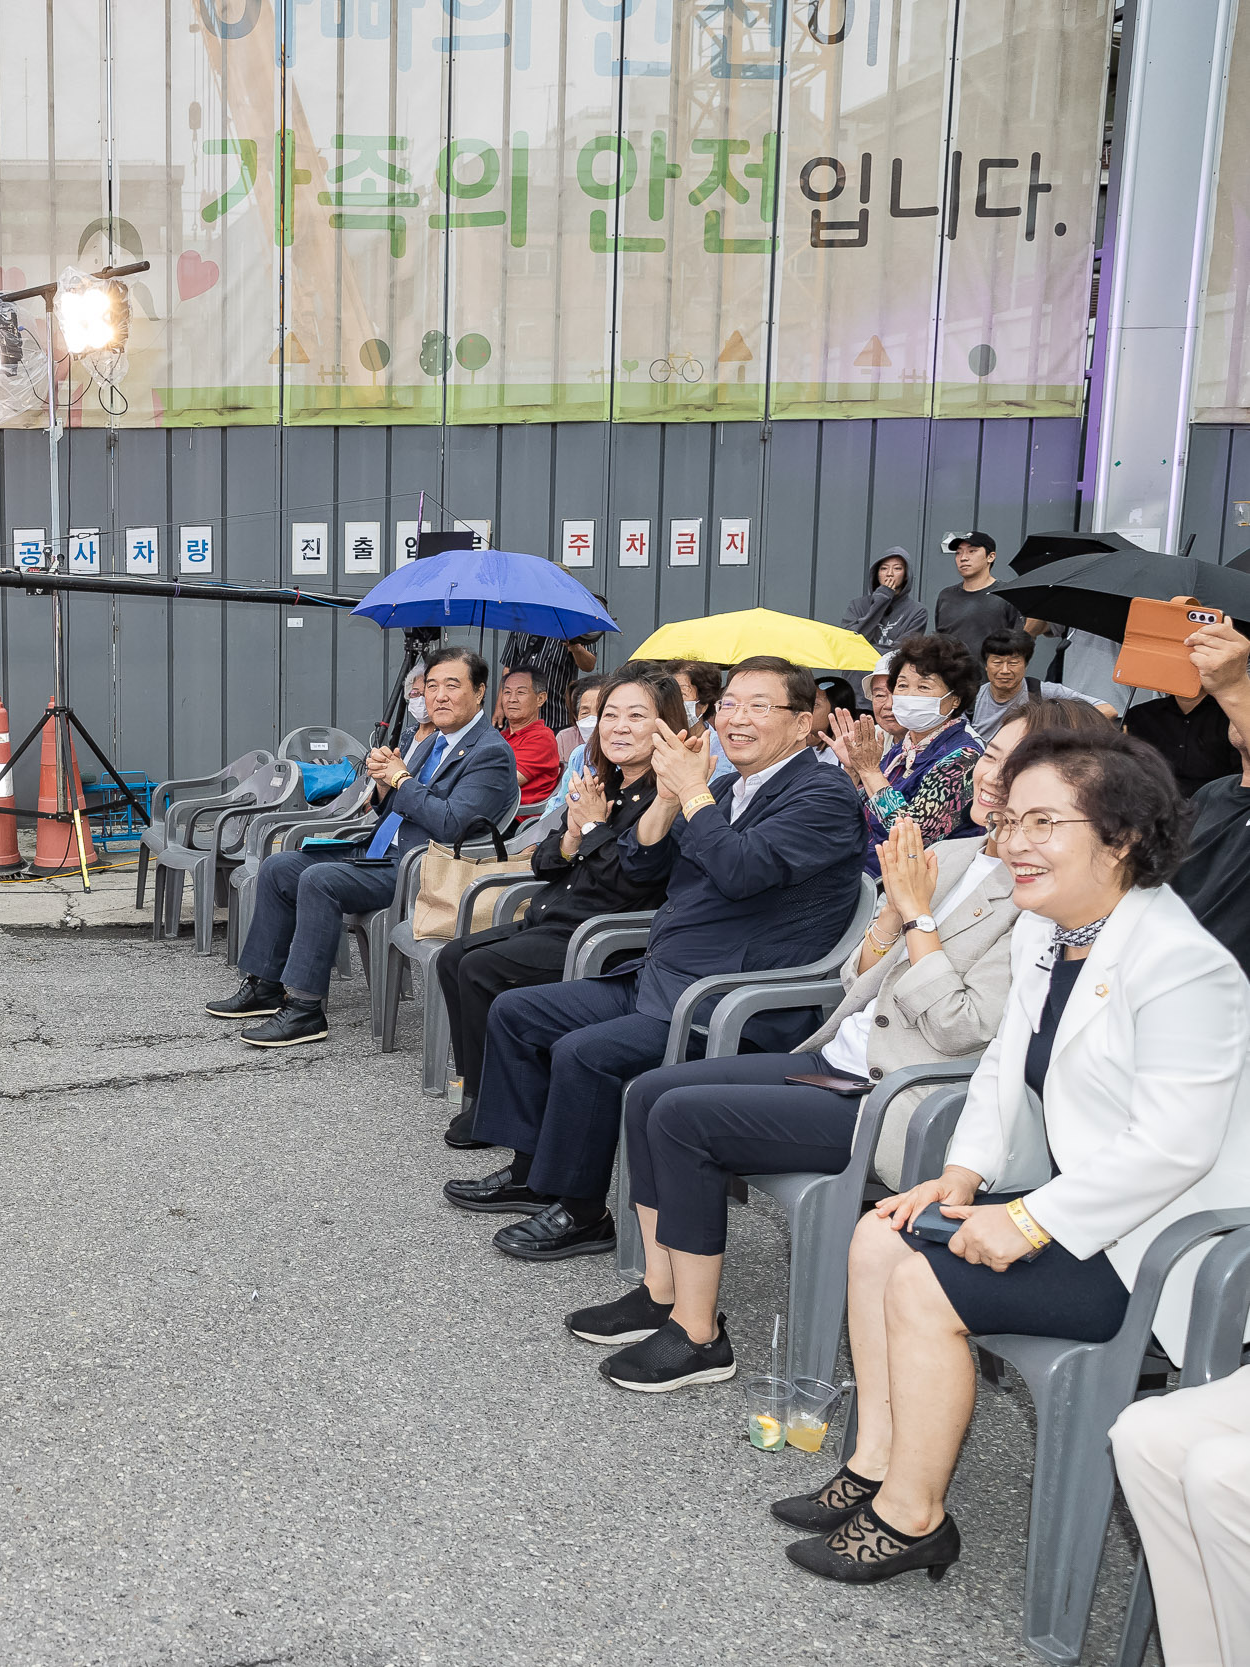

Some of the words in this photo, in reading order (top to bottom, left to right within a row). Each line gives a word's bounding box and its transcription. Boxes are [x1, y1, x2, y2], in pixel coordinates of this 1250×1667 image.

[202, 129, 527, 258] 가족의
[19, 541, 42, 566] 공
[74, 541, 96, 564] 사
[133, 540, 155, 563] 차
[187, 539, 209, 563] 량
[301, 537, 321, 560] 진
[352, 537, 374, 560] 출
[568, 533, 590, 556] 주
[625, 532, 646, 555] 차
[675, 532, 696, 555] 금
[725, 531, 745, 554] 지
